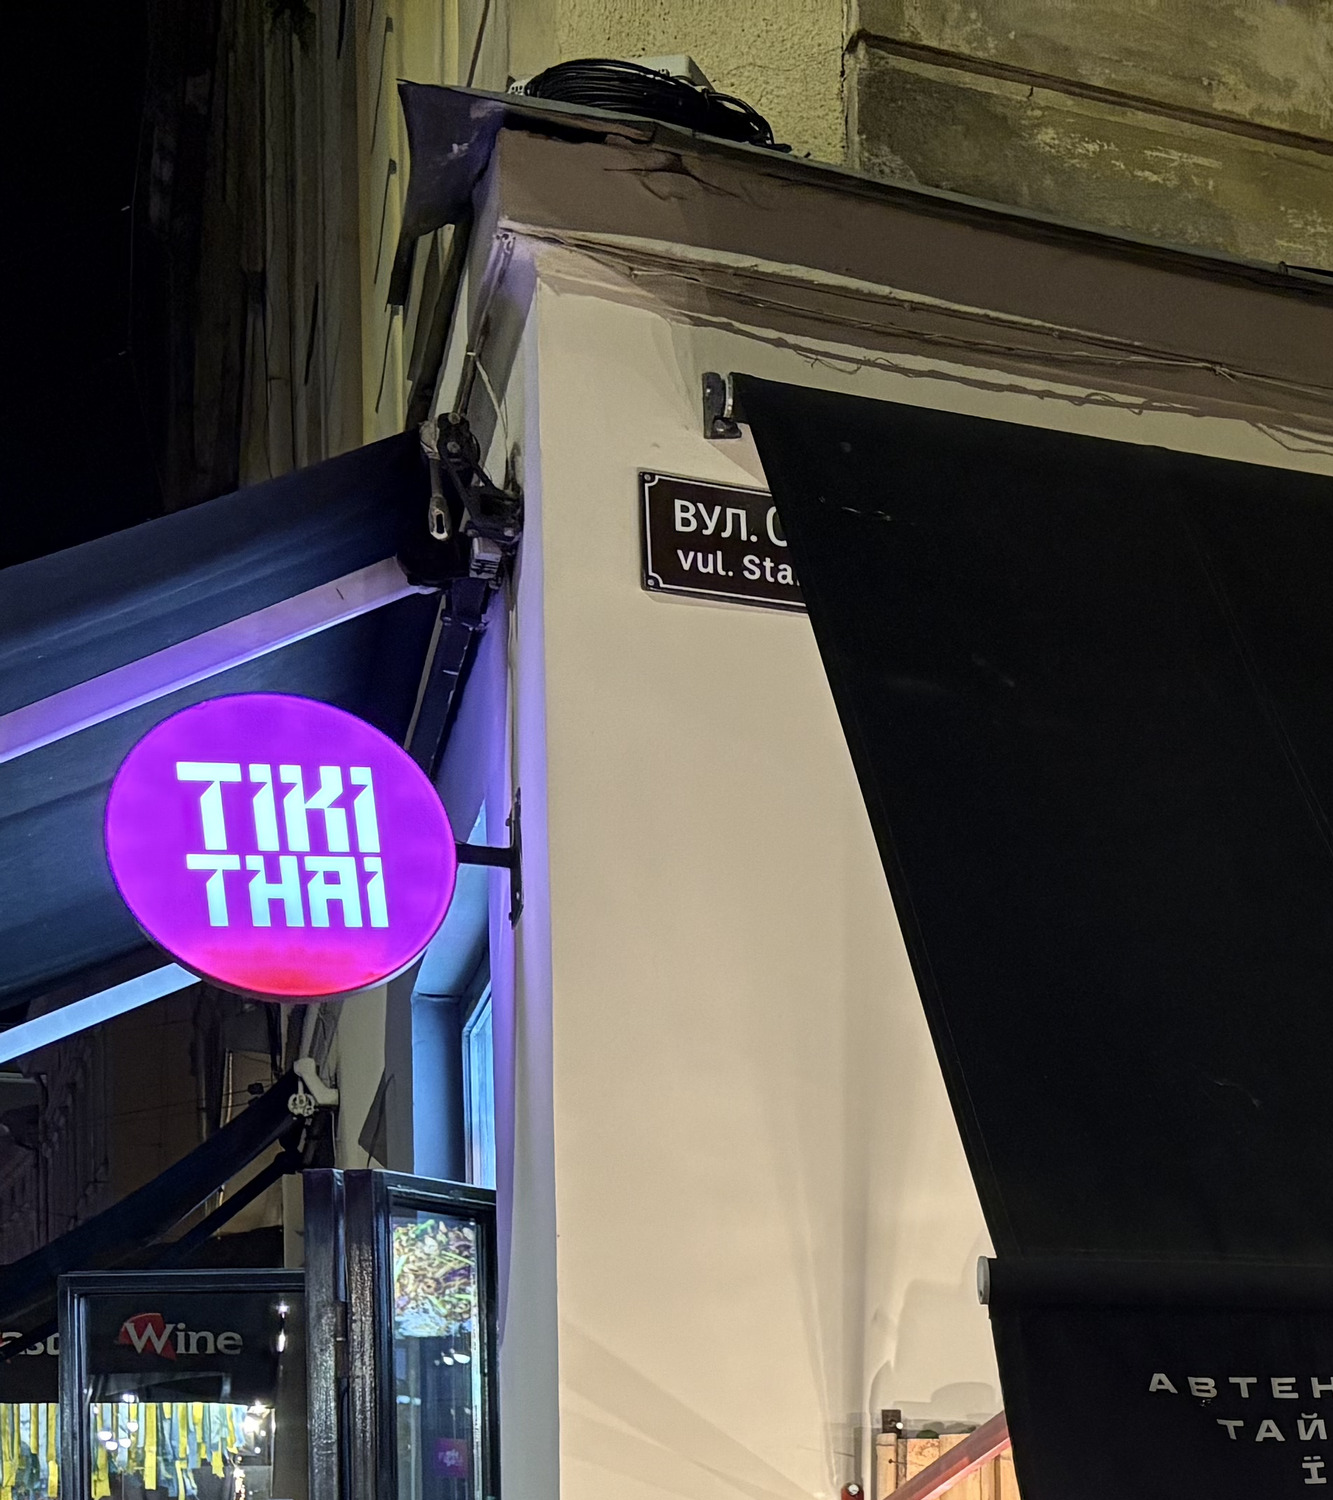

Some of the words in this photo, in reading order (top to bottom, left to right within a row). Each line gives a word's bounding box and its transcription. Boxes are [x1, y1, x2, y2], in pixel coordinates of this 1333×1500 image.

[673, 497, 758, 542] ВУЛ.
[676, 548, 734, 577] vul.
[741, 554, 803, 587] Sta
[175, 761, 381, 852] TIKI
[185, 853, 389, 929] THAI
[124, 1321, 243, 1356] Wine
